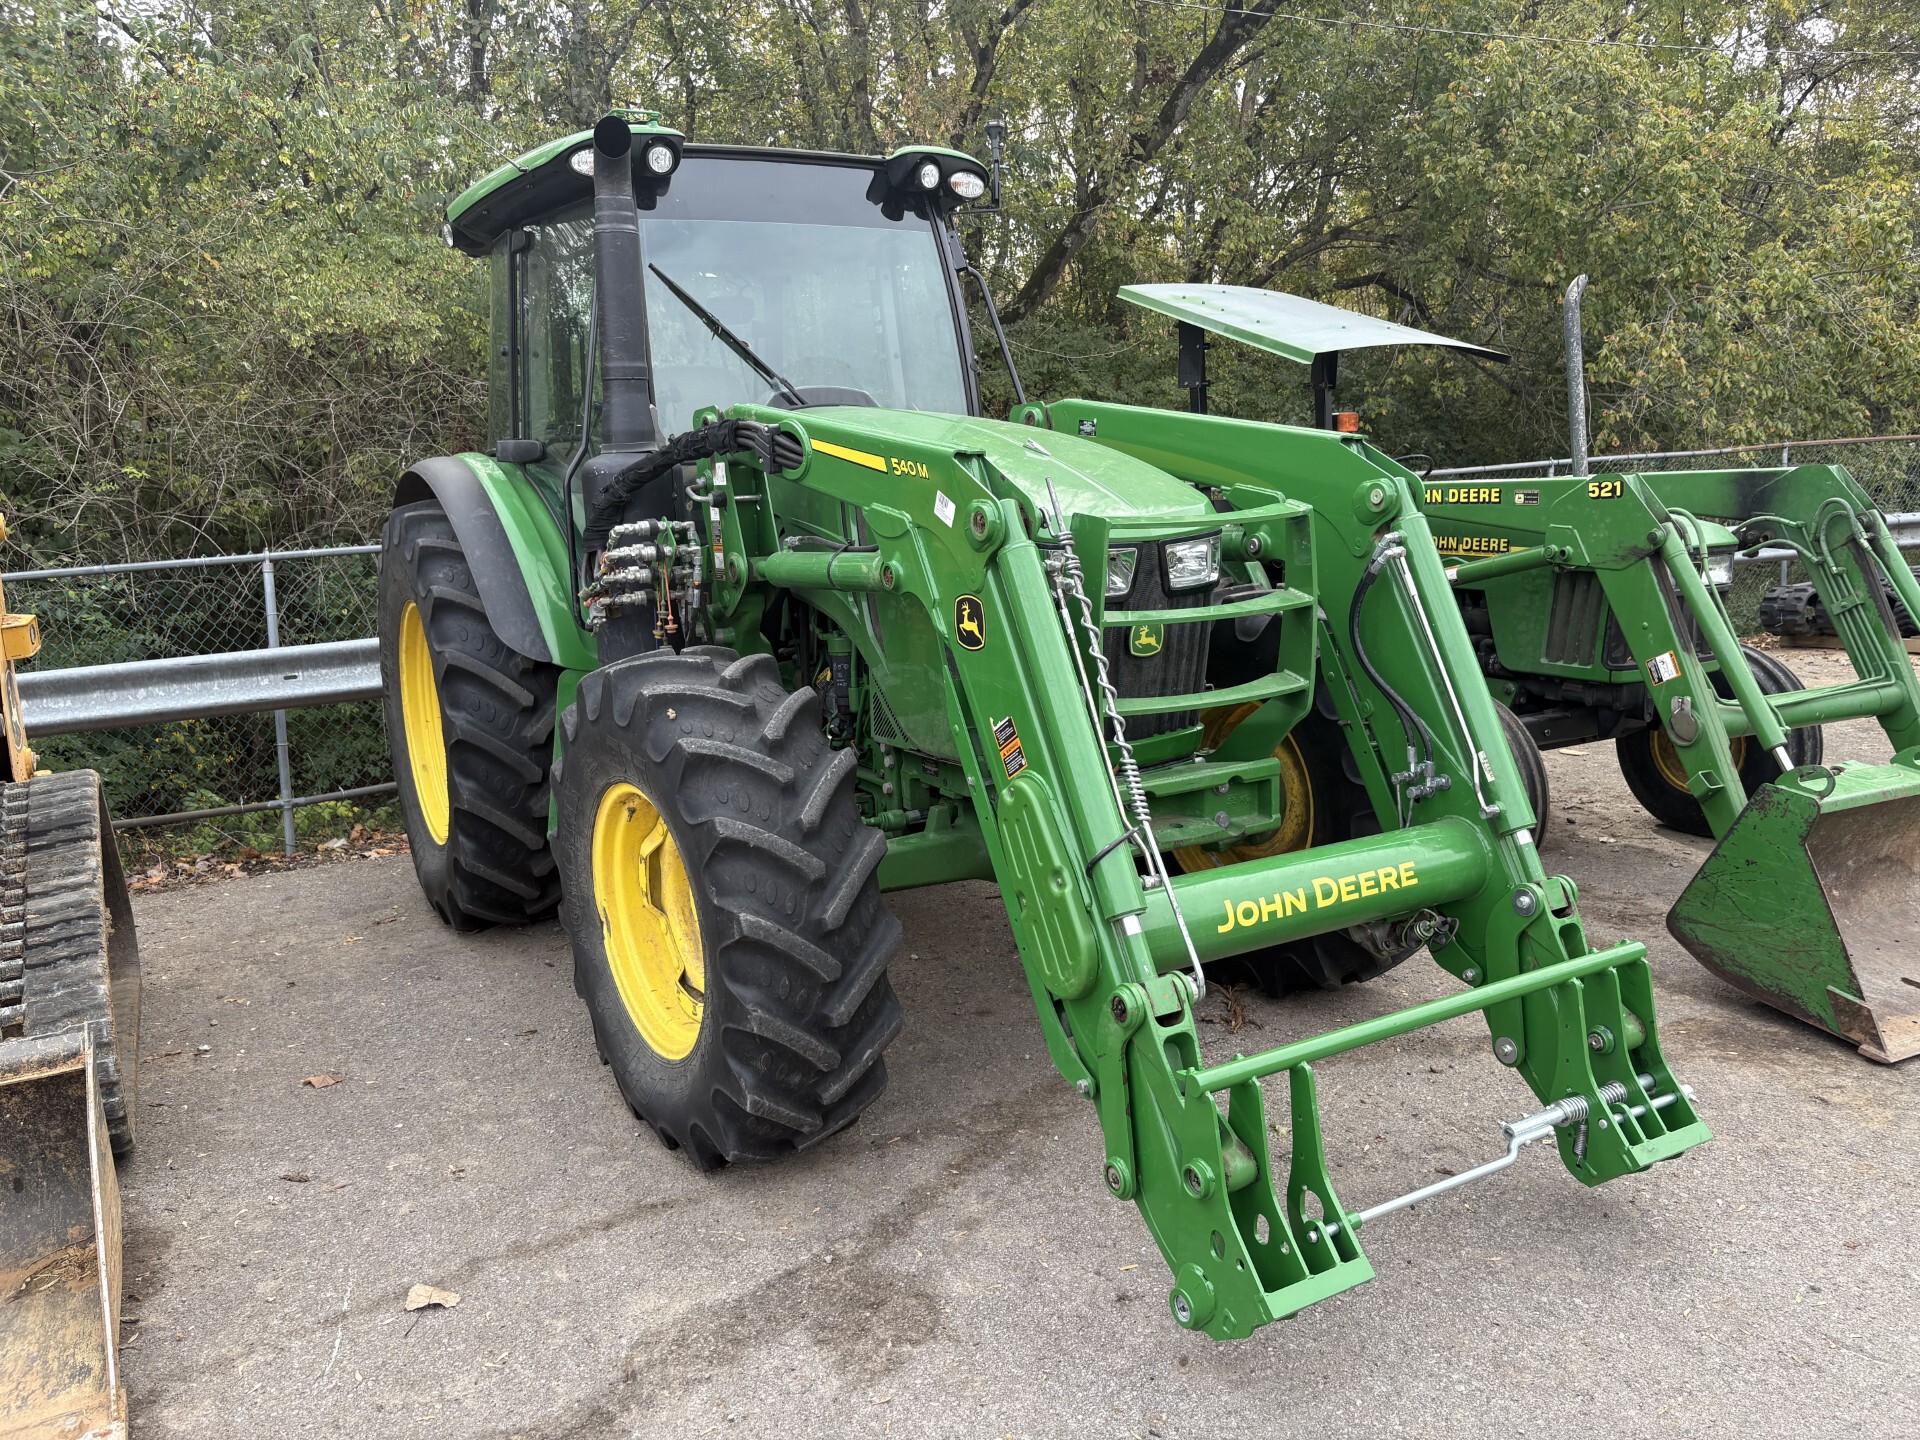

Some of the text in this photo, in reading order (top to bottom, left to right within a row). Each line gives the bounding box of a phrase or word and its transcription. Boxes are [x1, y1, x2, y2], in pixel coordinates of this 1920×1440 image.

[890, 457, 930, 480] 540 M
[1424, 488, 1501, 504] HN DEERE
[1588, 480, 1624, 499] 521
[1433, 536, 1510, 553] HN DEERE
[1217, 861, 1419, 934] JOHN DEERE
